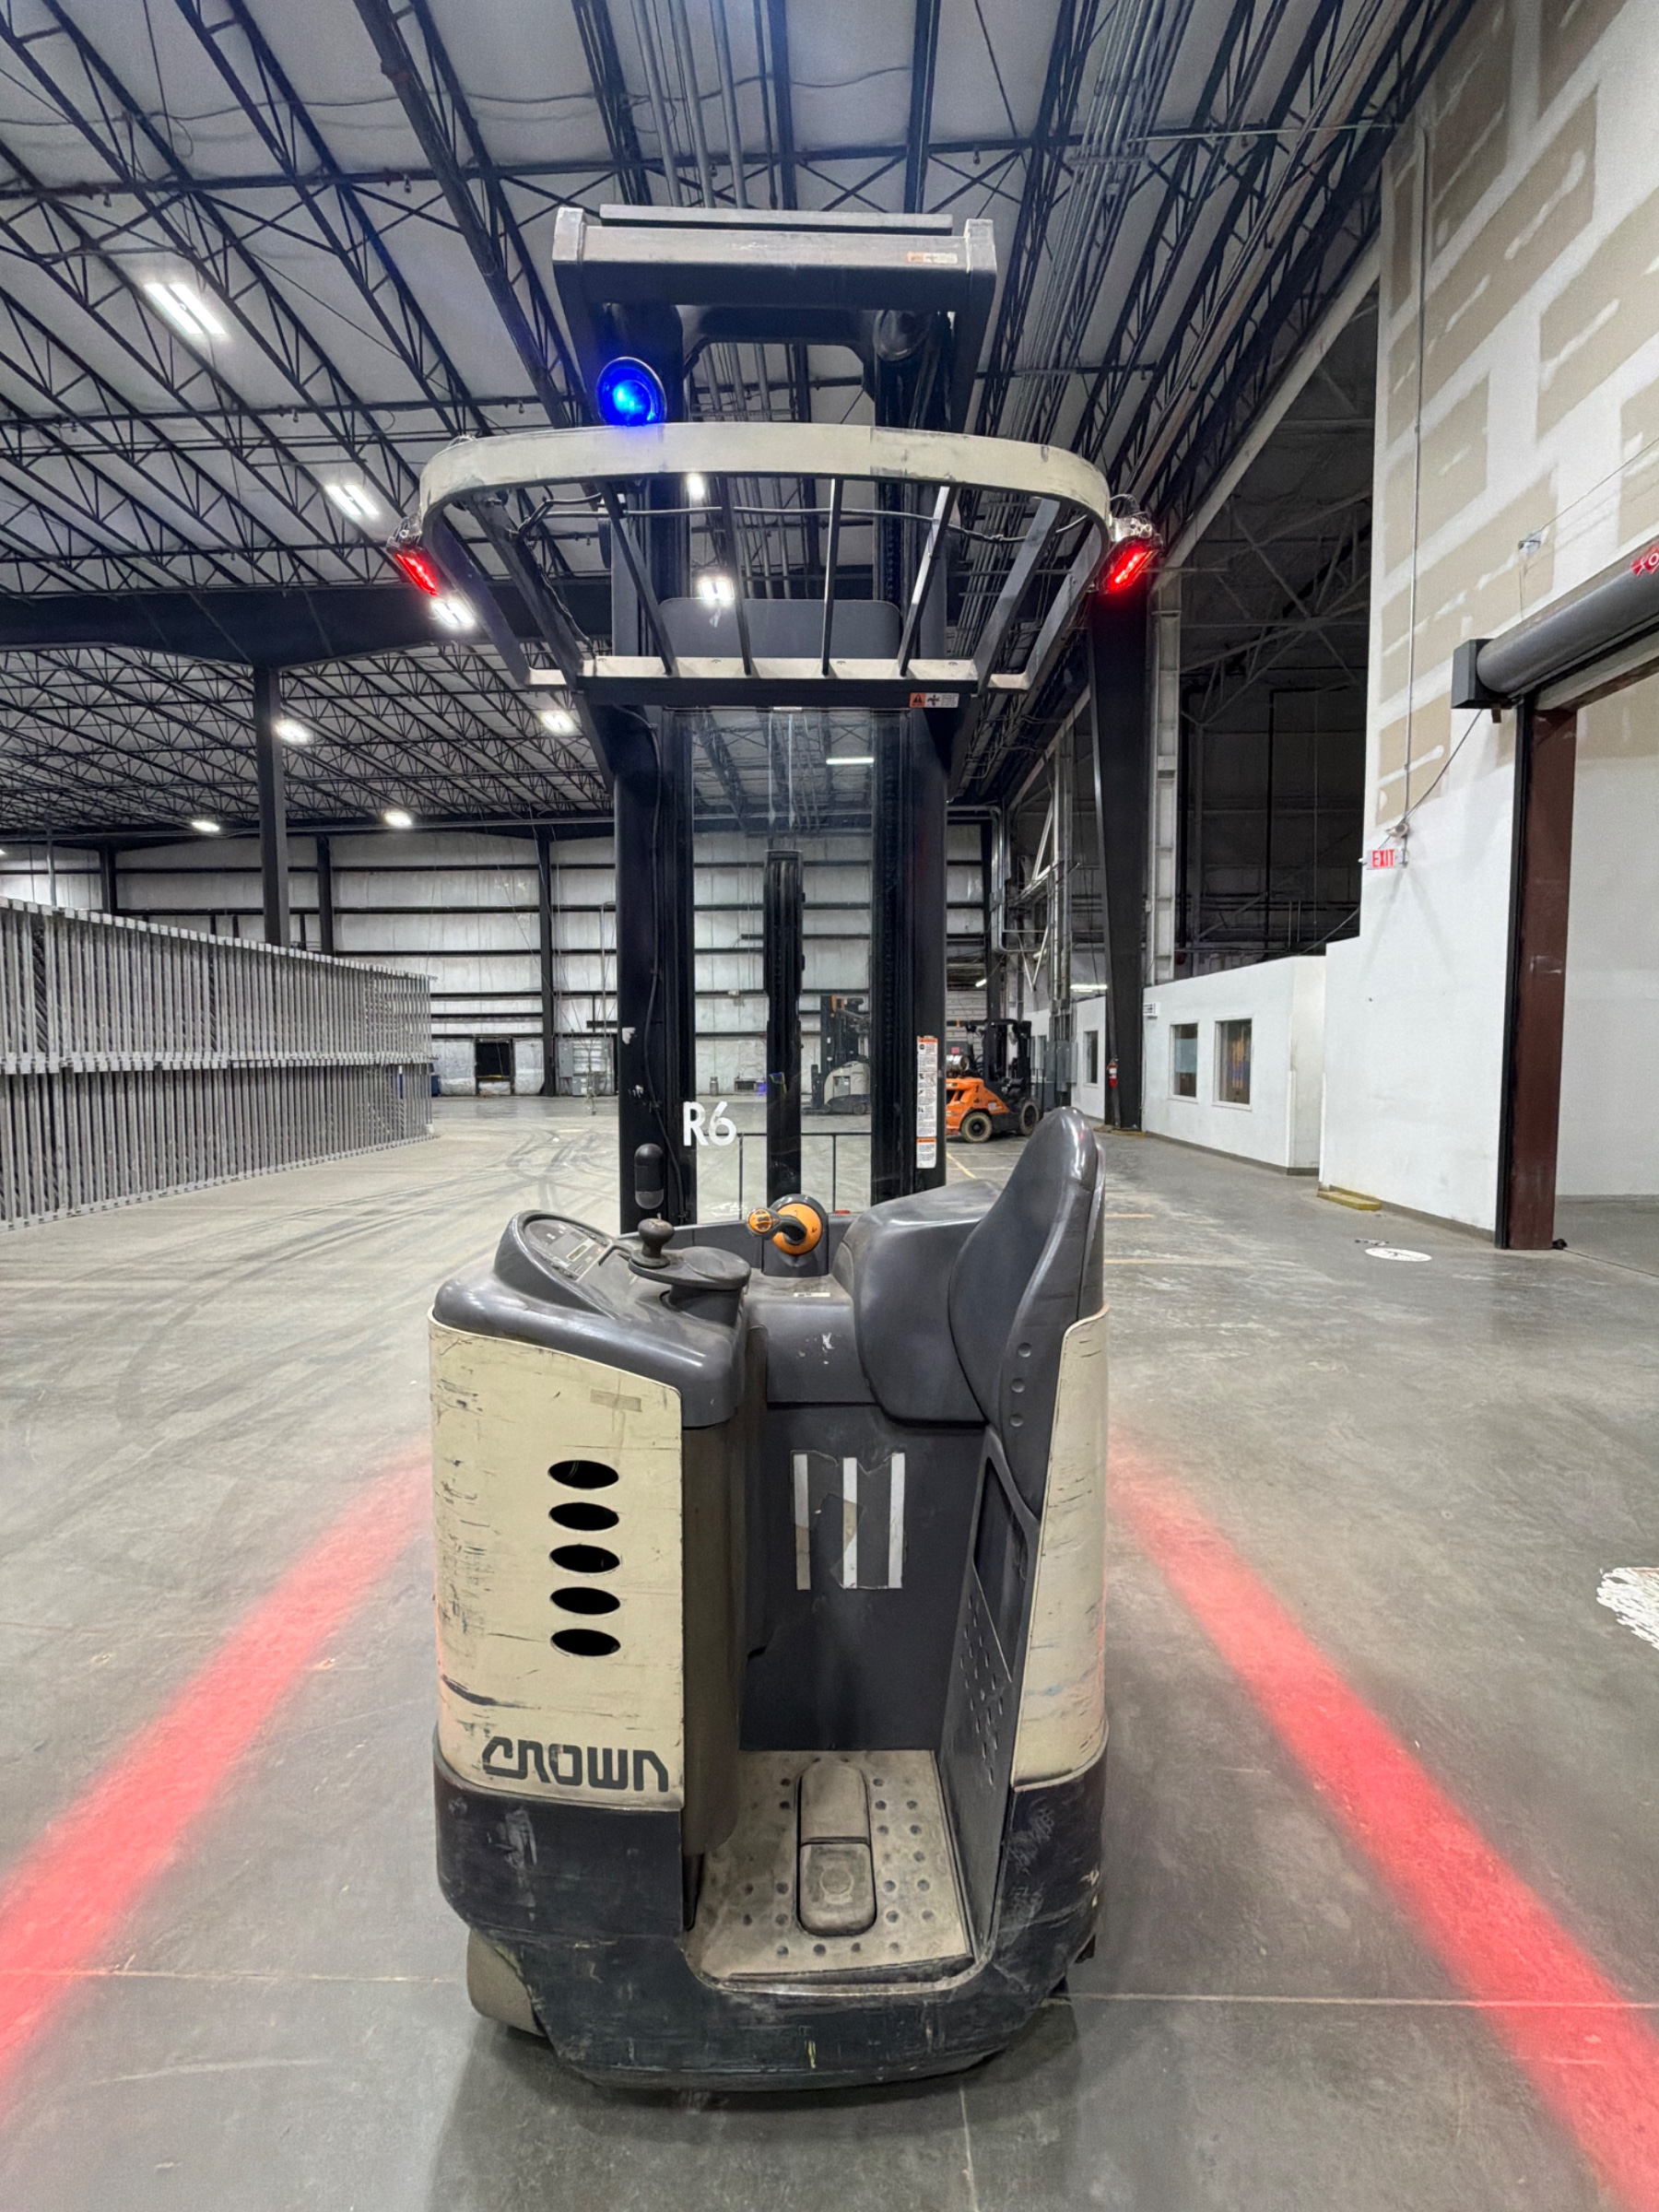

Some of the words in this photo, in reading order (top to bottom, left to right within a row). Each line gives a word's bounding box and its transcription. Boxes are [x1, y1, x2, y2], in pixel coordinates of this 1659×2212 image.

[1372, 849, 1394, 868] EXIT
[683, 1100, 737, 1147] R6
[482, 1735, 669, 1793] CROWN
